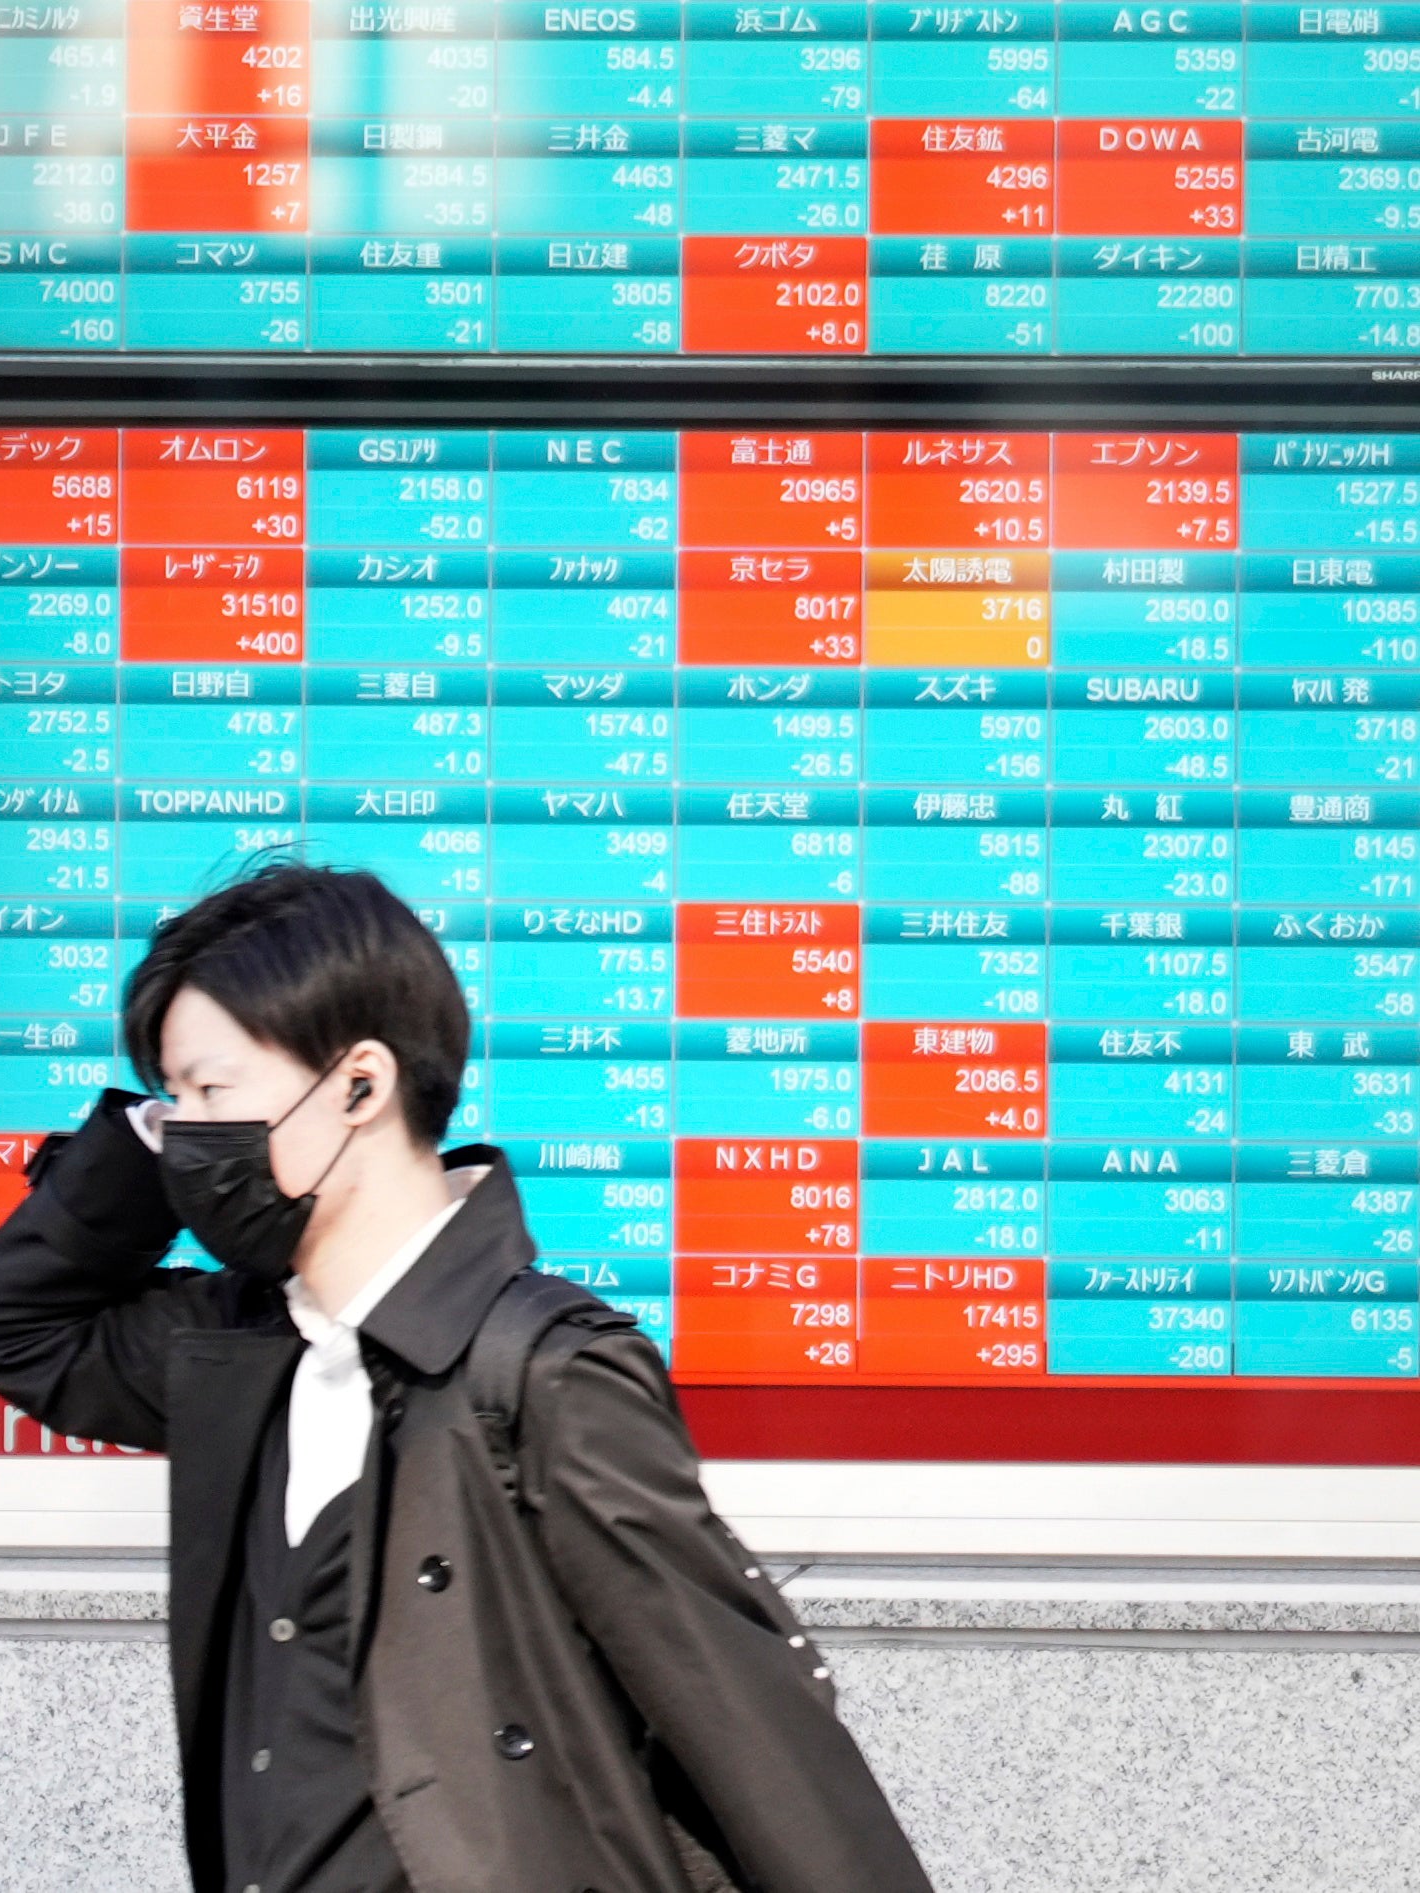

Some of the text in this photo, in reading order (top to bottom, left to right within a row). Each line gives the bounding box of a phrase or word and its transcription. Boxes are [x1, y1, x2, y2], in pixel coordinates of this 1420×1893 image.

[180, 5, 259, 32] 資生堂
[544, 8, 636, 32] ENEOS
[735, 5, 817, 33] 浜ゴム
[241, 45, 301, 69] 4202
[606, 45, 675, 71] 584.5
[799, 47, 861, 72] 3296
[255, 84, 302, 107] +16
[547, 122, 629, 152] 三井金
[920, 124, 1006, 152] 住友鉱
[1099, 126, 1201, 152] DOWA
[611, 163, 674, 189] 4463
[986, 165, 1047, 189] 4296
[1001, 204, 1045, 227] +11
[1189, 204, 1235, 228] +33
[176, 242, 256, 267] コマツ
[548, 241, 628, 269] 日立建
[734, 241, 815, 269] クボタ
[1093, 243, 1203, 271] ダイキン
[39, 278, 115, 304] 74000
[611, 281, 673, 307] 3805
[775, 282, 860, 307] 2102.0
[1156, 283, 1233, 309] 22280
[805, 320, 860, 345] +8.0
[159, 435, 268, 462] オムロン
[730, 437, 810, 466] 富士通
[902, 438, 1013, 466] ルネサス
[1090, 437, 1200, 466] エプソン
[52, 474, 111, 499] 5688
[236, 474, 298, 500] 6119
[779, 477, 856, 503] 20965
[958, 478, 1044, 504] 2620.5
[66, 513, 112, 537] +15
[973, 516, 1044, 542] +10.5
[1176, 517, 1231, 543] +7.5
[729, 555, 812, 582] 京セラ
[902, 556, 1012, 583] 太陽誘電
[1101, 557, 1183, 585] 村田製
[26, 592, 111, 617] 2269.0
[221, 592, 297, 618] 31510
[794, 594, 859, 621] 8017
[1025, 634, 1044, 661] 0
[356, 673, 436, 699] 三菱自
[726, 673, 811, 702] ホンダ
[914, 673, 994, 702] スズキ
[1086, 675, 1202, 702] SUBARU
[411, 712, 483, 737] 487.3
[771, 711, 855, 739] 1499.5
[139, 790, 284, 815] TOPPANHD
[727, 792, 809, 819] 任天堂
[913, 792, 996, 819] 伊藤忠
[605, 830, 668, 856] 3499
[790, 831, 853, 859] 6818
[900, 912, 1008, 938] 三井住友
[1100, 912, 1183, 939] 千葉銀
[48, 945, 108, 969] 3032
[597, 946, 667, 973] 775.5
[791, 949, 853, 974] 5540
[978, 949, 1040, 977] 7352
[540, 1026, 621, 1053] 三井不
[911, 1024, 994, 1057] 東建物
[1098, 1029, 1182, 1058] 住友不
[1163, 1070, 1224, 1095] 4131
[984, 1107, 1039, 1131] +4.0
[538, 1143, 620, 1170] 川崎船
[1287, 1150, 1369, 1177] 三菱倉
[603, 1185, 665, 1209] 5090
[789, 1183, 851, 1210] 8016
[1163, 1189, 1227, 1213] 3063
[789, 1302, 850, 1327] 7298
[963, 1304, 1038, 1329] 17415
[1147, 1306, 1225, 1332] 37340
[1350, 1308, 1413, 1332] 6135
[804, 1341, 850, 1365] +26
[975, 1343, 1037, 1368] +295
